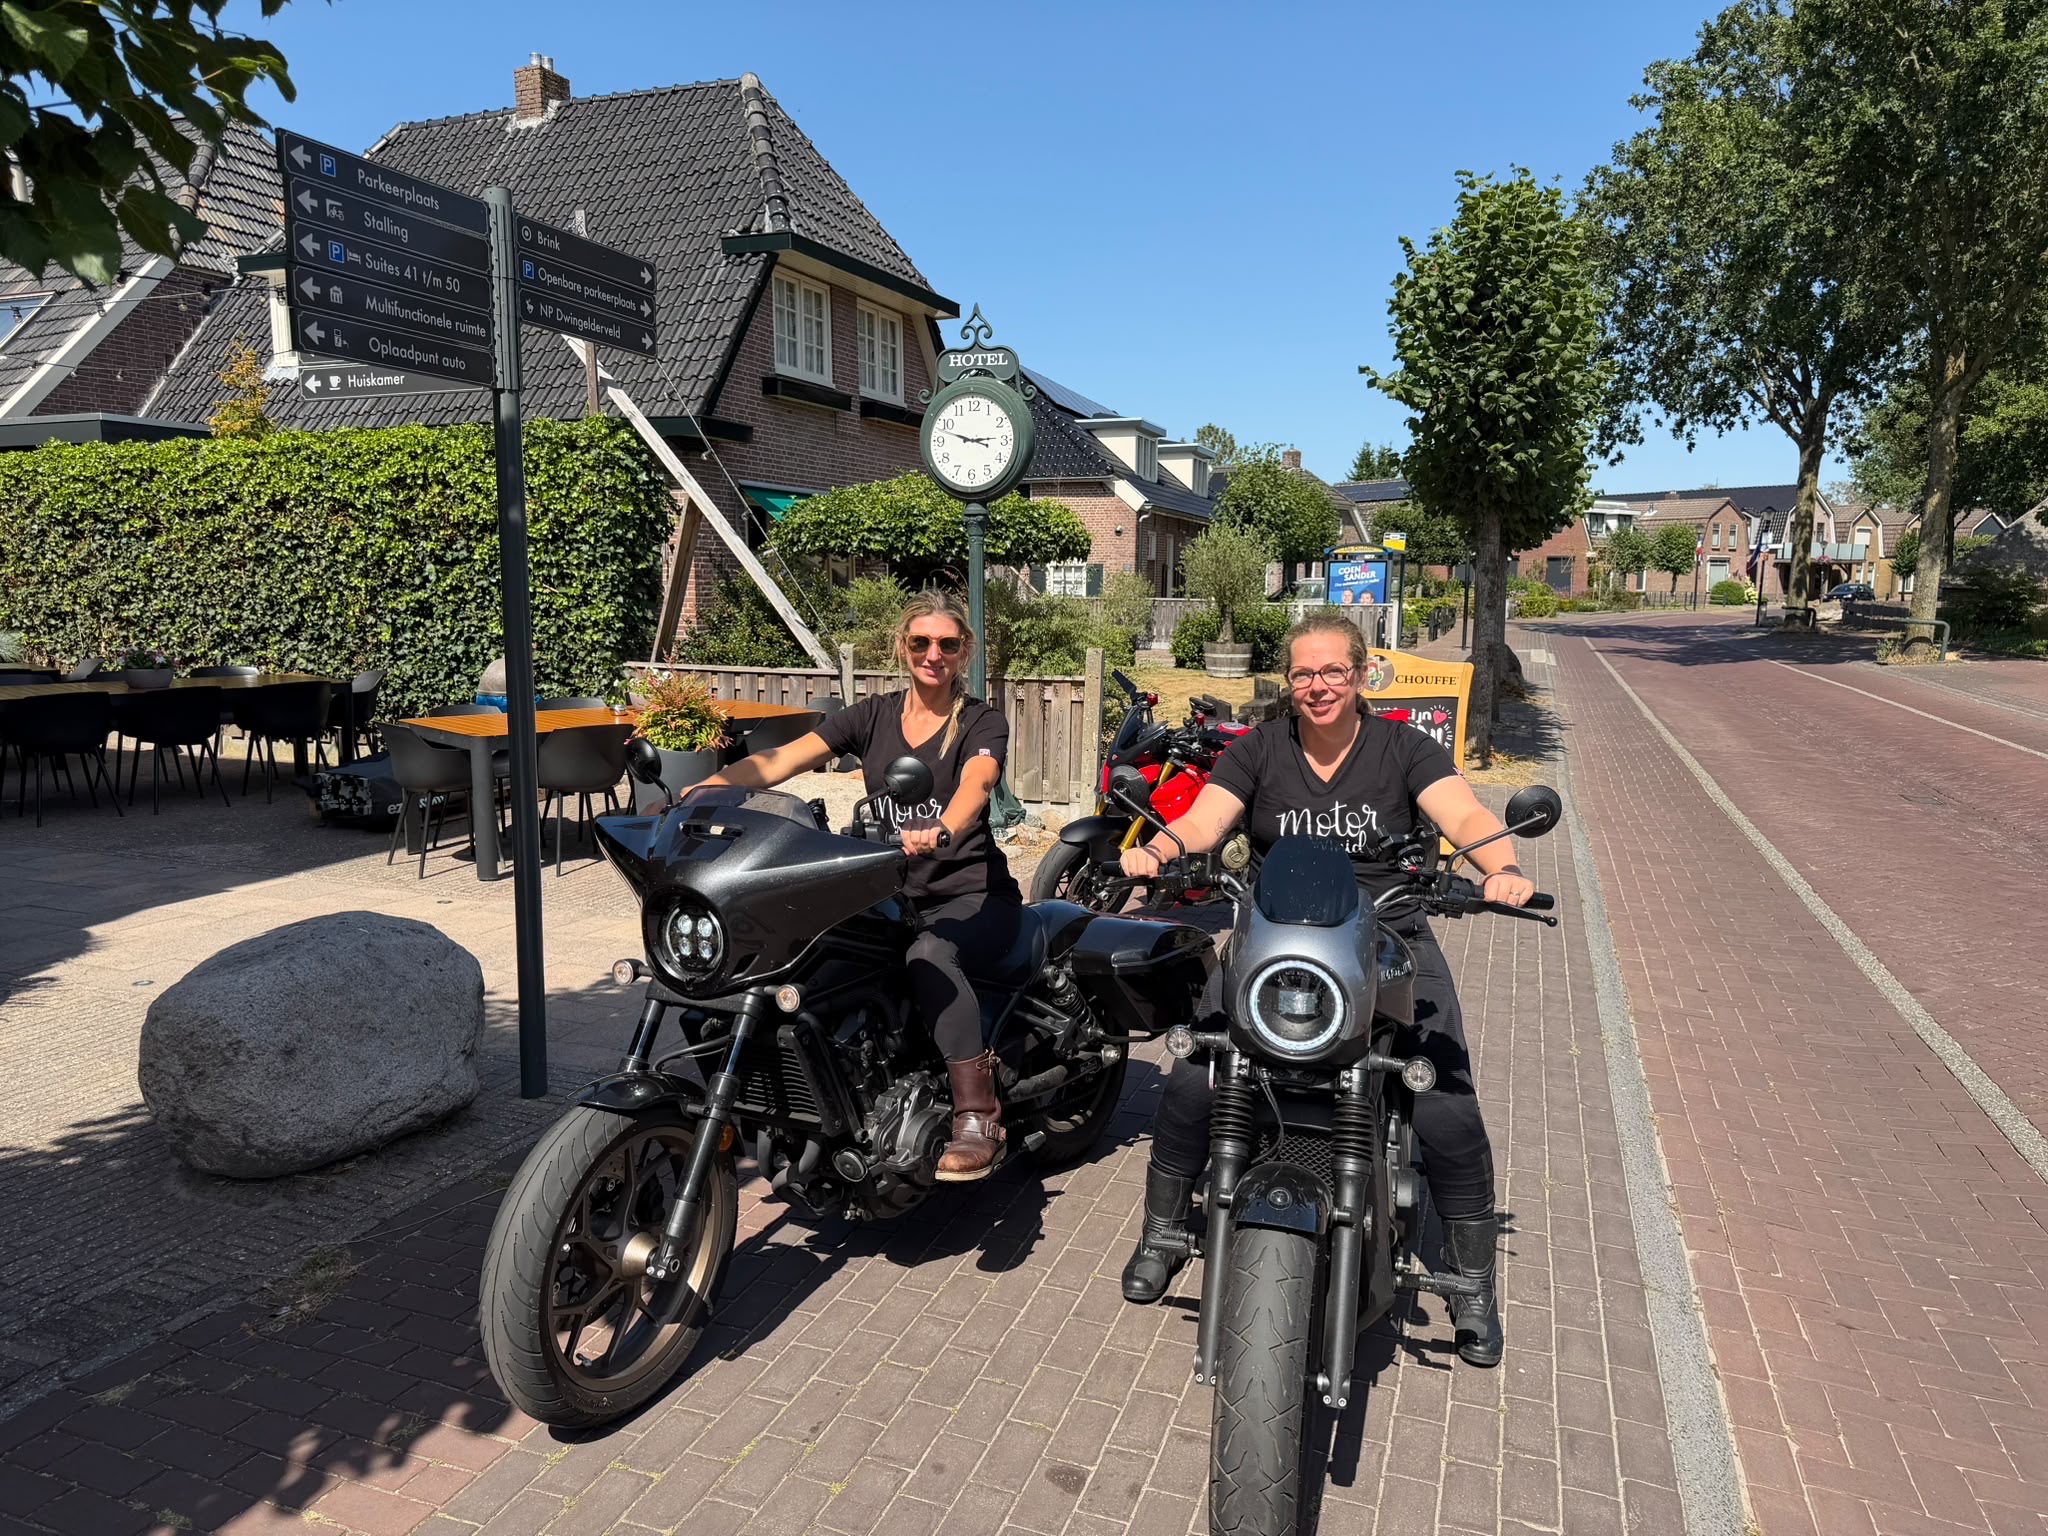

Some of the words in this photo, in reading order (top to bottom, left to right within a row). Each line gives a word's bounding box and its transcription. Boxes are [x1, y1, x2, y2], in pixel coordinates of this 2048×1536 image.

[358, 169, 440, 211] Parkeerplaats
[364, 211, 409, 243] Stalling
[537, 231, 561, 251] Brink
[365, 253, 400, 276] Suites
[403, 265, 418, 282] 41
[422, 270, 442, 288] t/m
[446, 277, 460, 293] 50
[538, 267, 582, 293] Openbare
[583, 285, 637, 311] parkeerplaats
[365, 296, 452, 330] Multifunctionele
[455, 320, 486, 338] ruimte
[540, 303, 554, 318] NP
[556, 308, 621, 339] Dwingelderveld
[369, 337, 439, 367] Oplaadpunt
[442, 356, 466, 370] auto
[949, 353, 1008, 367] HOTEL
[348, 372, 405, 388] Huiskamer
[954, 405, 964, 416] 11
[968, 400, 980, 412] 12
[986, 404, 991, 416] 1
[942, 418, 954, 430] 10
[996, 417, 1004, 428] 2
[936, 436, 945, 447] 9
[1000, 435, 1008, 446] 3
[941, 452, 950, 463] 8
[995, 452, 1004, 463] 4
[953, 465, 962, 476] 7
[967, 469, 976, 480] 6
[983, 464, 991, 476] 5
[1338, 564, 1361, 576] COEN
[1344, 570, 1377, 582] SANDER
[1395, 674, 1457, 686] CHOUFFE
[1408, 708, 1432, 724] ijn
[1275, 800, 1377, 837] Motor
